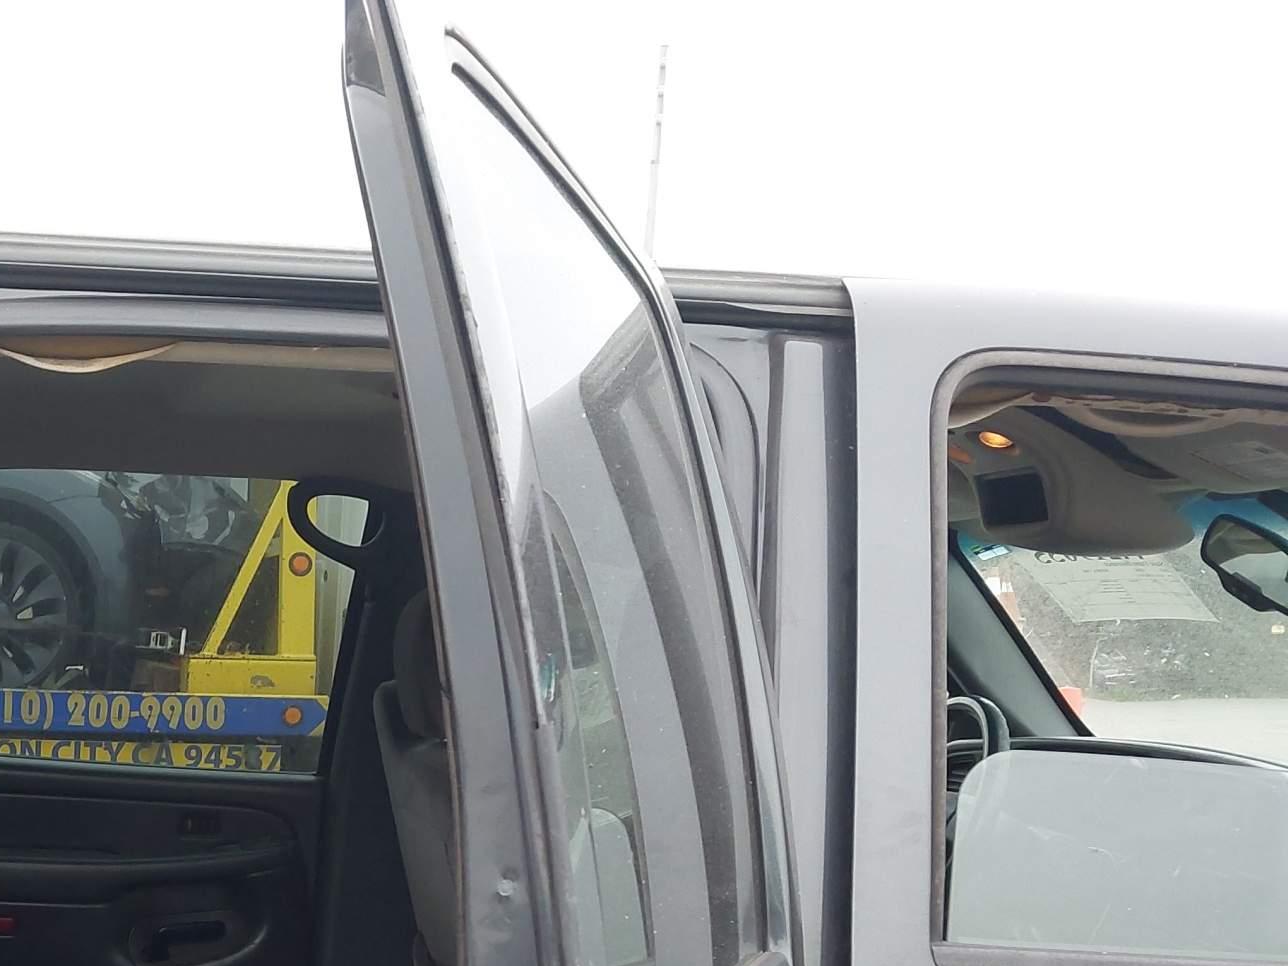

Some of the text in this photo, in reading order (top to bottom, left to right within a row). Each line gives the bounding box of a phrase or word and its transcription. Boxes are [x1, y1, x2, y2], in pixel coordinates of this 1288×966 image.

[67, 690, 226, 731] 200-9900
[52, 739, 123, 764] CITY
[132, 742, 174, 766] CA
